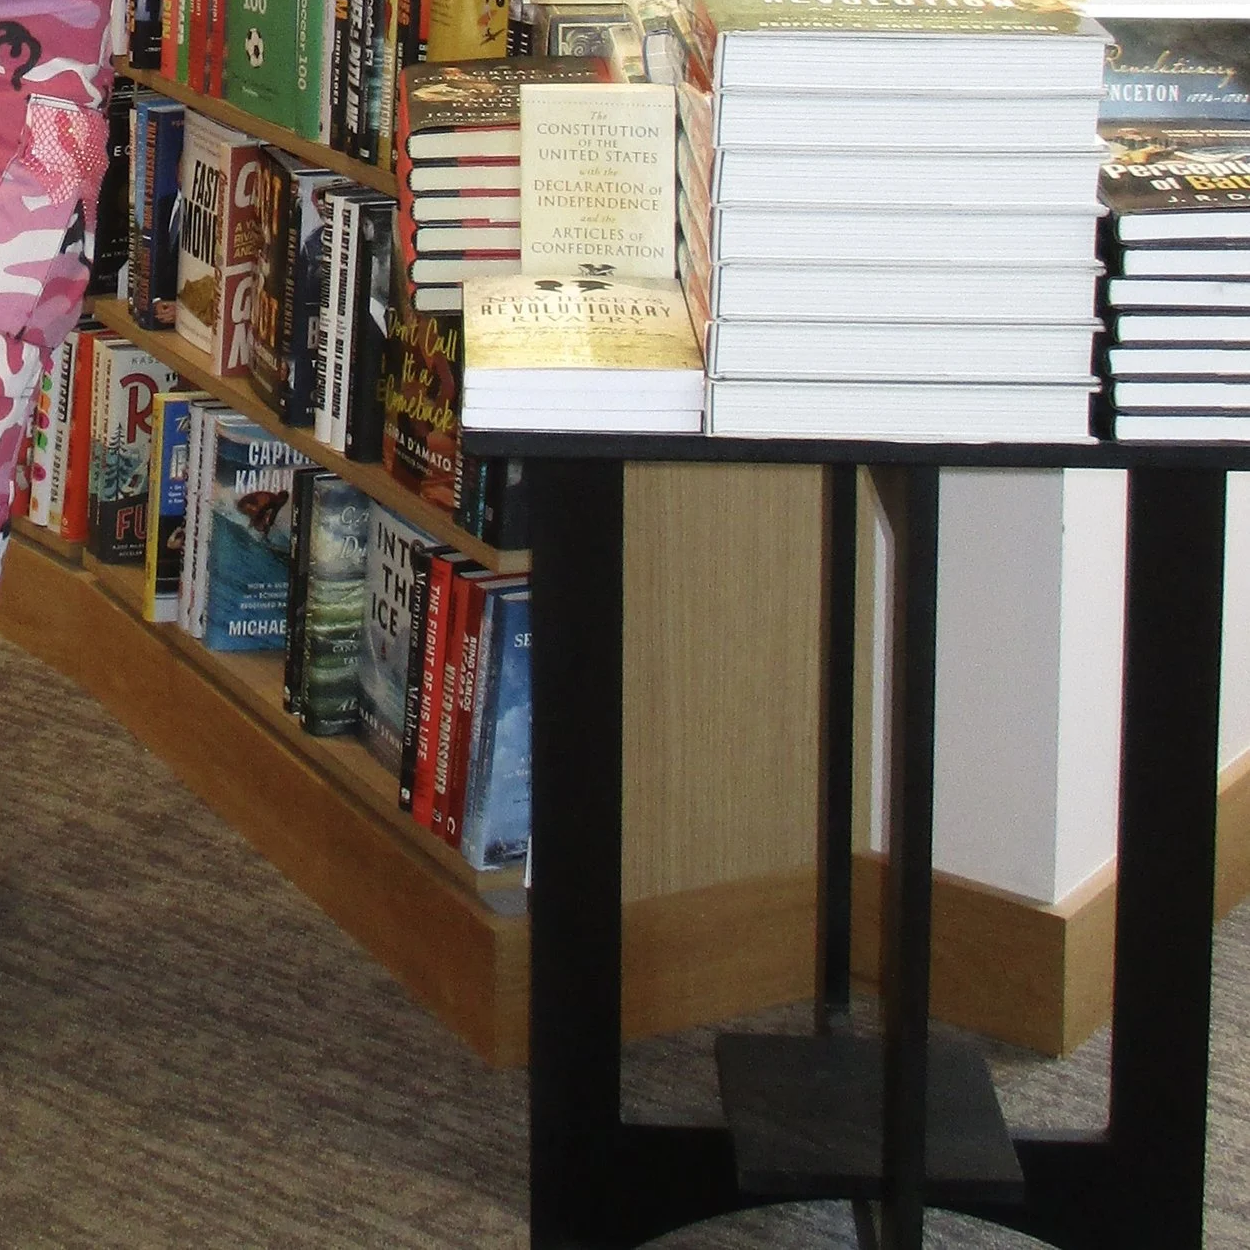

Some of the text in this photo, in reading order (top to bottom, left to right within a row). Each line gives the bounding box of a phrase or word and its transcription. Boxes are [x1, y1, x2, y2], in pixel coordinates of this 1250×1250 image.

[536, 122, 660, 139] CONSTITUTION
[538, 148, 659, 165] UNITED STATES
[533, 178, 664, 196] DECLARATION OF
[537, 195, 660, 212] INDEPENDENCE
[552, 226, 644, 242] ARTICLES OF
[531, 240, 666, 259] CONFEDERATION
[480, 303, 672, 319] REVOLUTIONARY
[423, 317, 459, 363] Call
[235, 468, 294, 495] KAHAN
[371, 592, 399, 638] ICE
[410, 570, 427, 648] Mornings
[229, 618, 287, 637] MICHAE
[417, 617, 439, 762] FIGHT HIS LIFE
[403, 686, 419, 747] Madden
